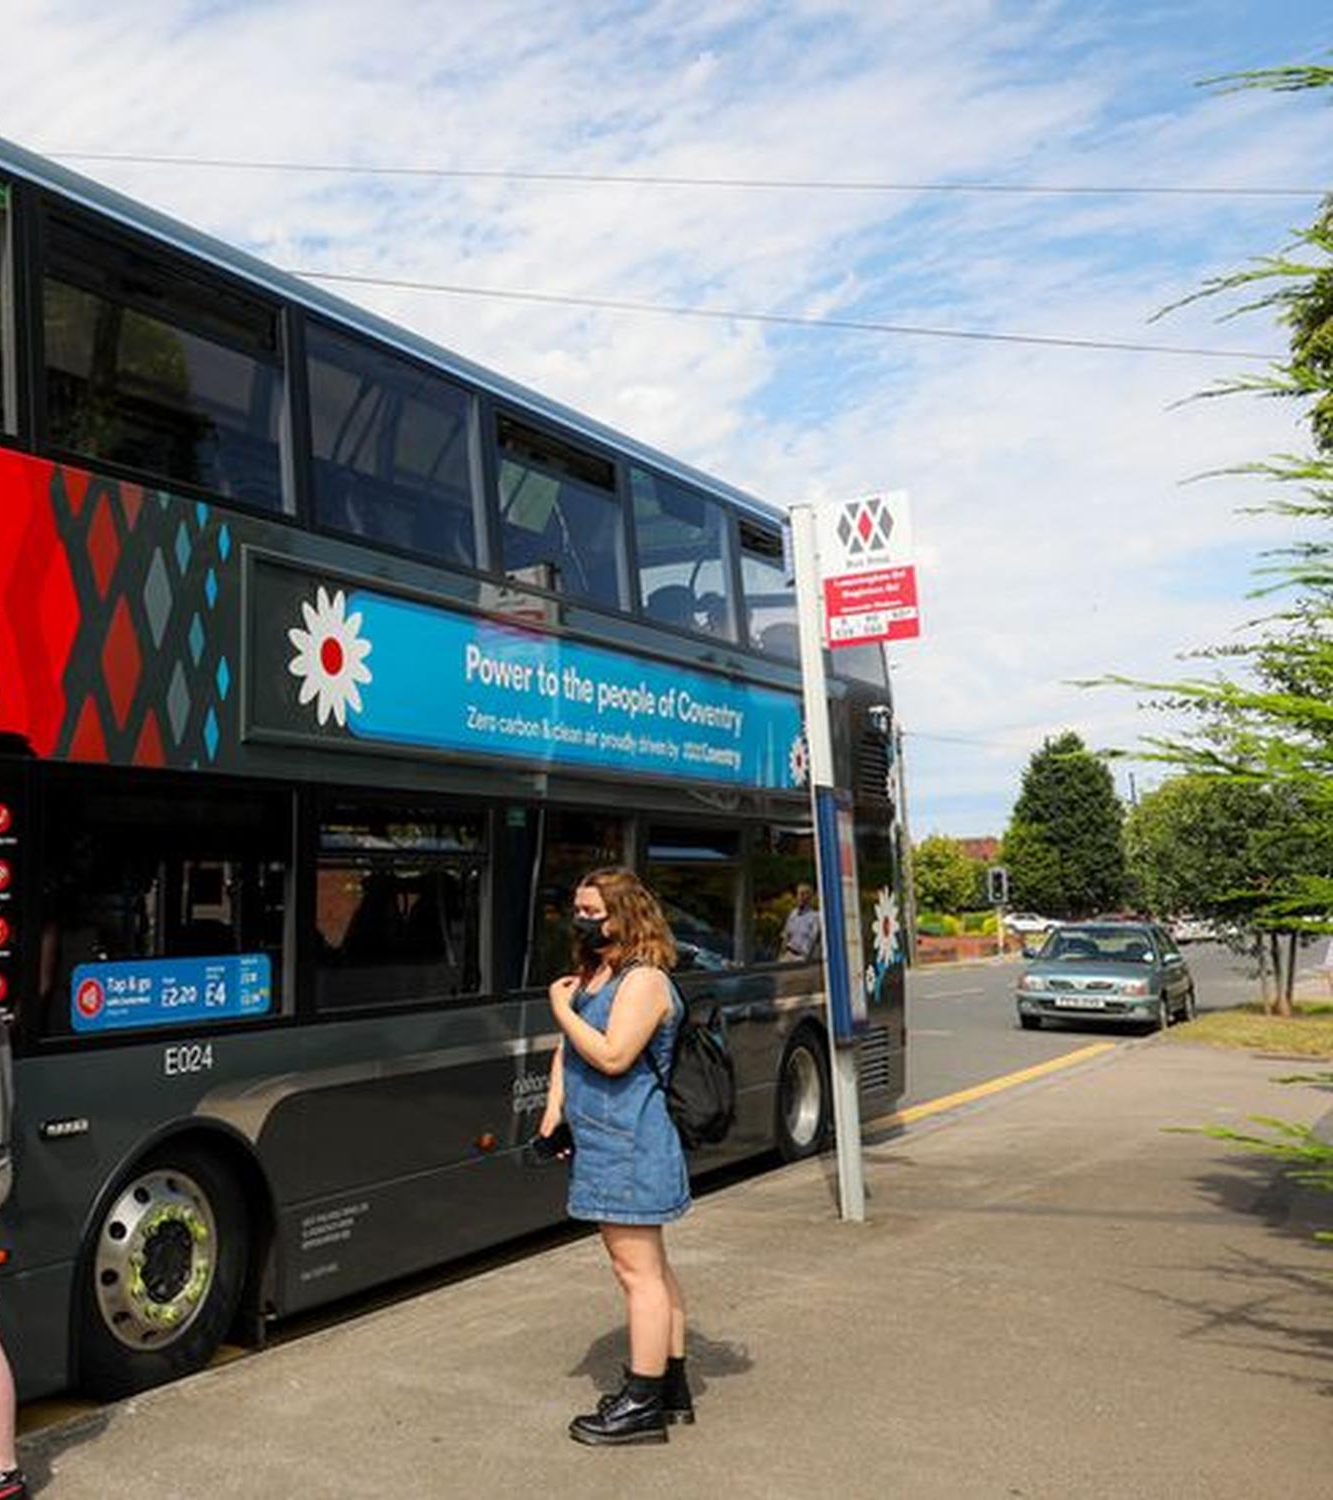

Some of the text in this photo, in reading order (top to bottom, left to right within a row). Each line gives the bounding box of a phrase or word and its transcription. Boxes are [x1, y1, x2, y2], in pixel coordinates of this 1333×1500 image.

[466, 645, 744, 738] Power to the people of Coventry
[466, 705, 498, 733] Zero
[499, 712, 540, 738] carbon
[553, 721, 584, 744] clean
[107, 976, 127, 994] Tap
[138, 977, 153, 993] go
[204, 981, 226, 1008] £4
[165, 1043, 214, 1075] E024
